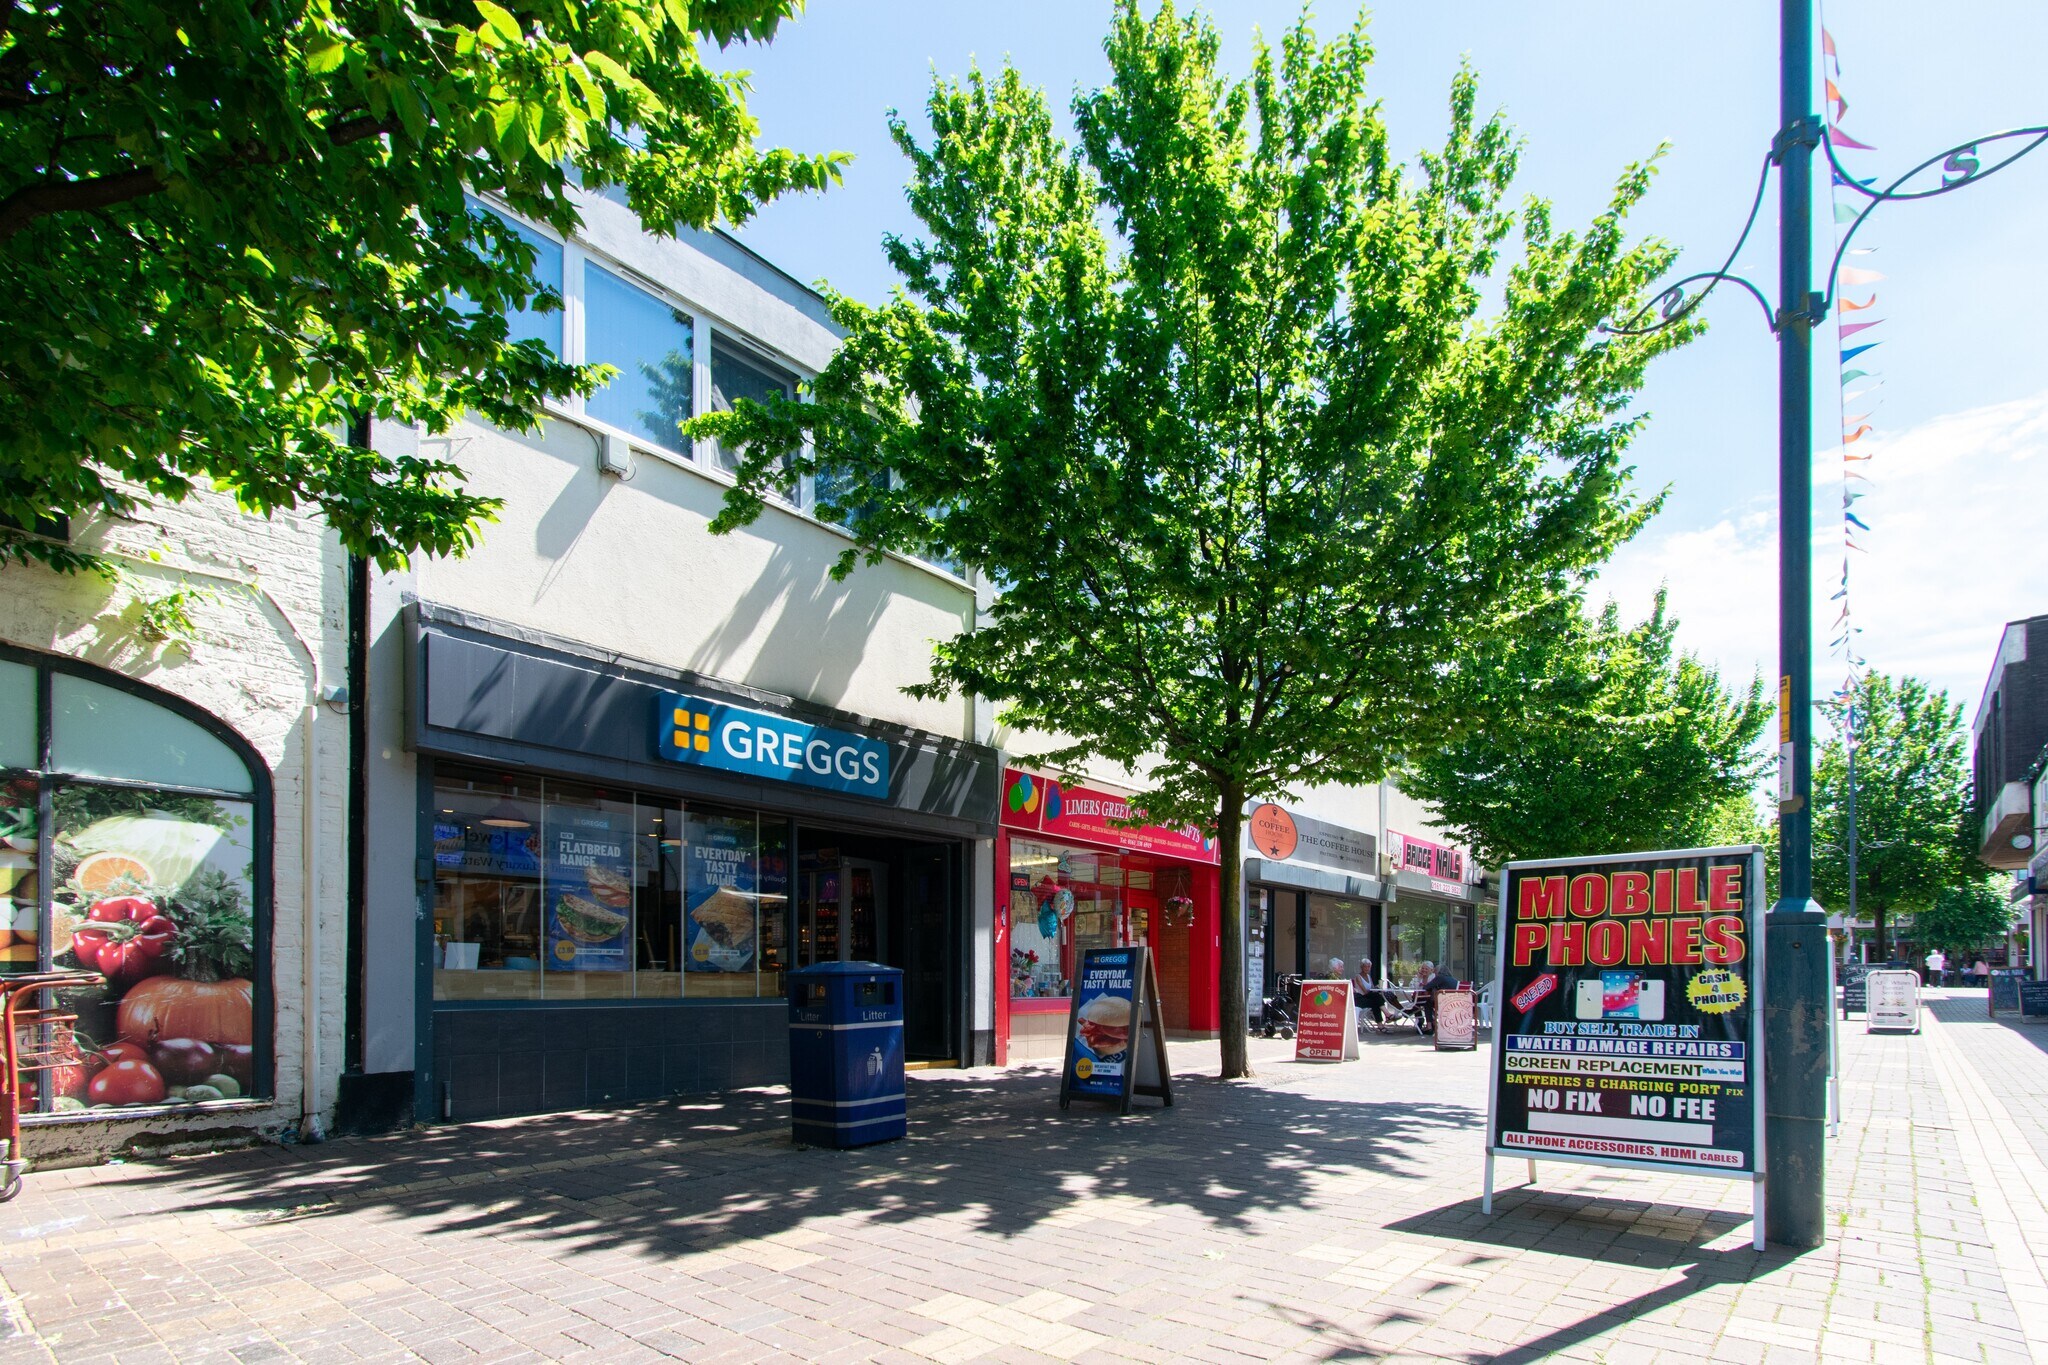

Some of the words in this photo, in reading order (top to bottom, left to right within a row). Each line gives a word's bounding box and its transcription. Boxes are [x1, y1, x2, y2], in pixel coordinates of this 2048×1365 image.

[722, 720, 880, 786] GREGGS
[1065, 800, 1100, 816] LIMERS
[1180, 820, 1201, 844] GIFTS
[1259, 820, 1290, 834] COFFEE
[560, 841, 621, 857] FLATBREAD
[695, 846, 746, 862] EVERYDAY
[1300, 834, 1318, 846] THE
[1320, 839, 1350, 852] COFFEE
[1351, 846, 1375, 858] HOUSE
[560, 854, 596, 867] RANGE
[705, 860, 738, 874] TASTY
[1407, 844, 1432, 868] BRIDGE
[1436, 848, 1460, 880] NAILS
[706, 873, 737, 886] VALUE
[1014, 878, 1028, 887] OPEN
[1518, 864, 1742, 920] MOBILE
[1514, 916, 1746, 966] PHONES
[1100, 955, 1127, 964] GREGGS
[1090, 969, 1127, 980] EVERYDAY
[1698, 972, 1730, 984] CASH
[1083, 980, 1105, 989] TASTY
[1108, 979, 1132, 989] VALUE
[1712, 984, 1719, 993] 4
[1517, 977, 1552, 1009] SAEED
[1694, 992, 1740, 1005] PHONES
[800, 1011, 820, 1022] Litter
[862, 1010, 887, 1022] Litter
[1544, 1020, 1576, 1036] BUY
[1577, 1022, 1618, 1037] SELL
[1618, 1022, 1676, 1038] TRADE
[1678, 1024, 1699, 1039] IN
[1517, 1037, 1572, 1051] WATER
[1576, 1038, 1648, 1055] DAMAGE
[1652, 1042, 1732, 1057] REPAIRS
[1507, 1056, 1571, 1070] SCREEN
[1577, 1059, 1703, 1077] REPLACEMENT
[1506, 1074, 1581, 1087] BATTERIES
[1586, 1077, 1595, 1088] &
[1600, 1078, 1674, 1093] CHARGING
[1679, 1082, 1721, 1096] PORT
[1726, 1088, 1744, 1097] FIX
[1528, 1088, 1560, 1110] NO
[1565, 1091, 1602, 1113] FIX
[1630, 1094, 1666, 1117] NO
[1673, 1098, 1715, 1120] FEE
[1506, 1133, 1525, 1144] ALL
[1528, 1135, 1566, 1148] PHONE
[1660, 1147, 1696, 1160] HDMI
[1700, 1152, 1738, 1164] CABLES
